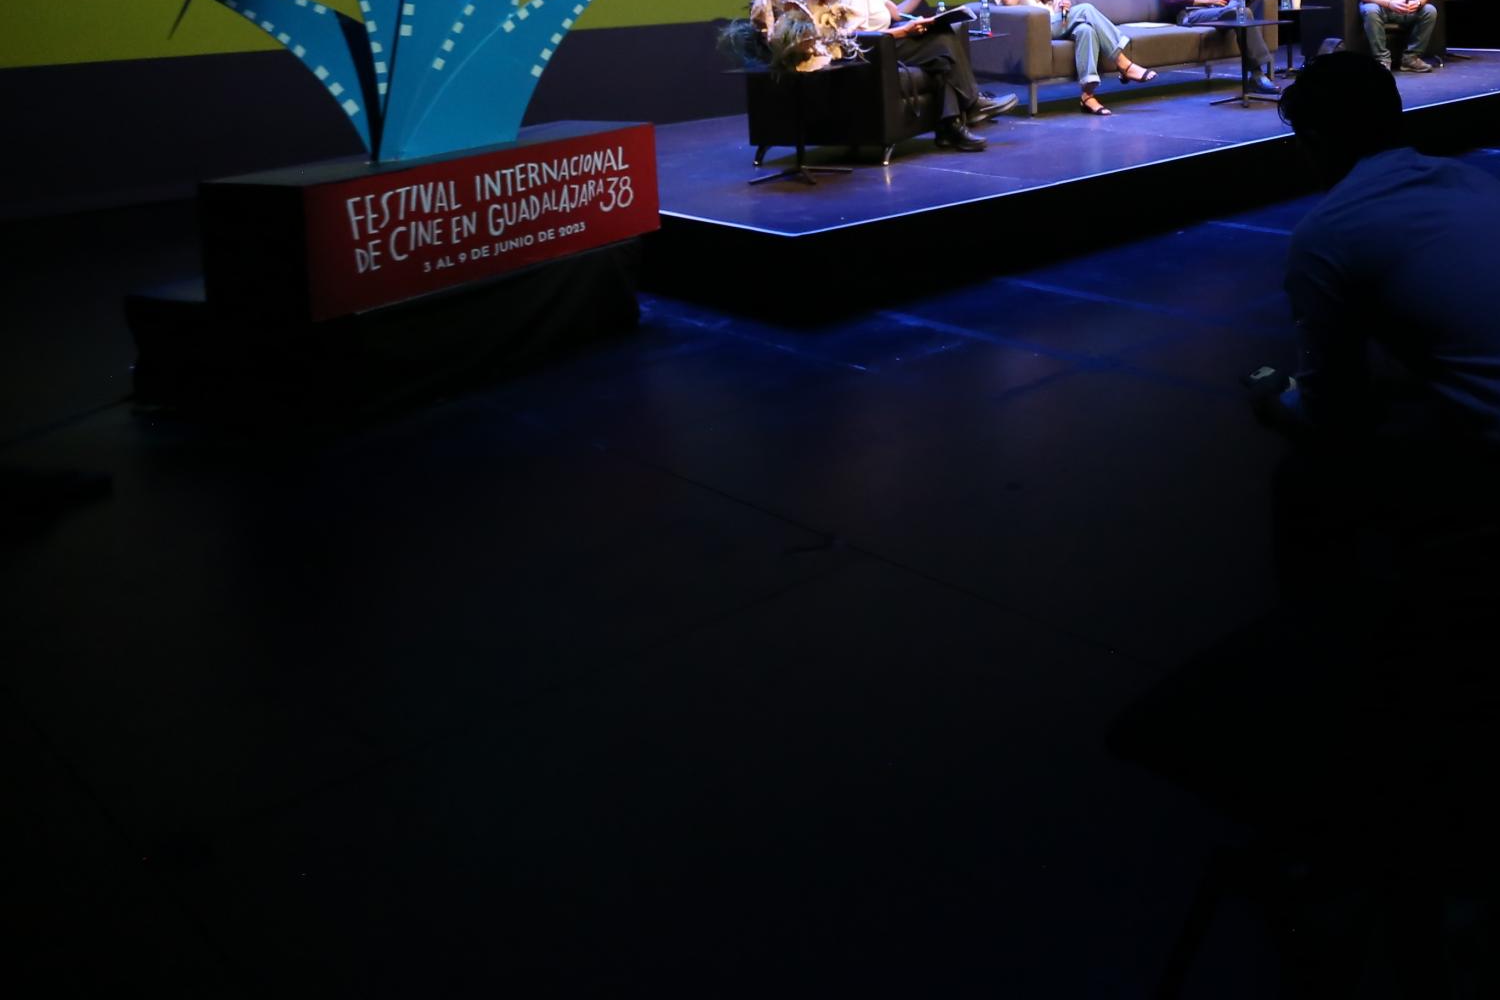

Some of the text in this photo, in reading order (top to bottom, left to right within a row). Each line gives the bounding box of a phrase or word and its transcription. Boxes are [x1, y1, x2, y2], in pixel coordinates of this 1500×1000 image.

[346, 146, 629, 240] FESTIVAL INTERNACIONAL
[354, 175, 634, 274] DE CINE EN GUADALAJARA 38
[422, 220, 586, 273] 3 AL 9 DE JUNIO DE 2023
